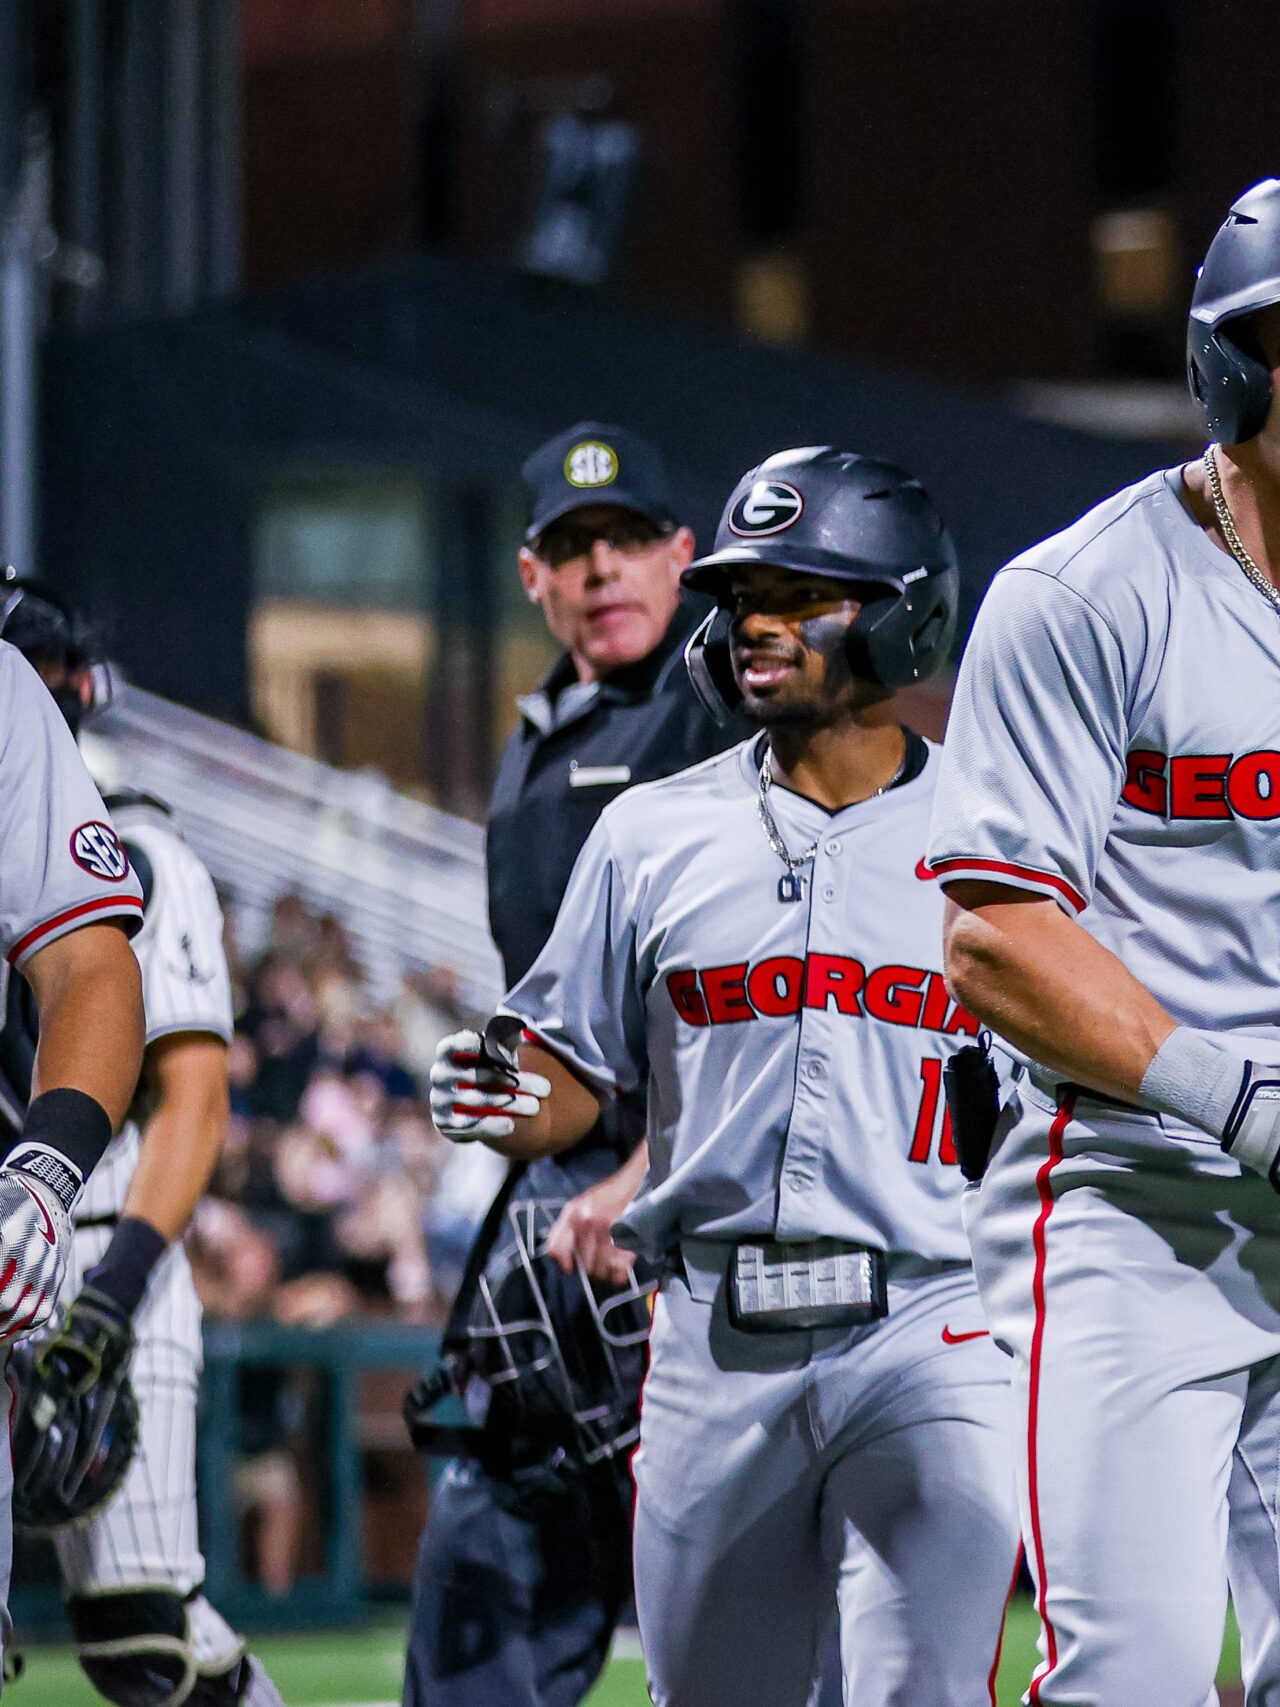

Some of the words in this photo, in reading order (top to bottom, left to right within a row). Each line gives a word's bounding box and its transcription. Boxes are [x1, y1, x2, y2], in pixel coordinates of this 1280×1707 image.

[742, 481, 801, 525] G
[74, 823, 126, 878] SEC
[908, 1057, 958, 1165] 1
